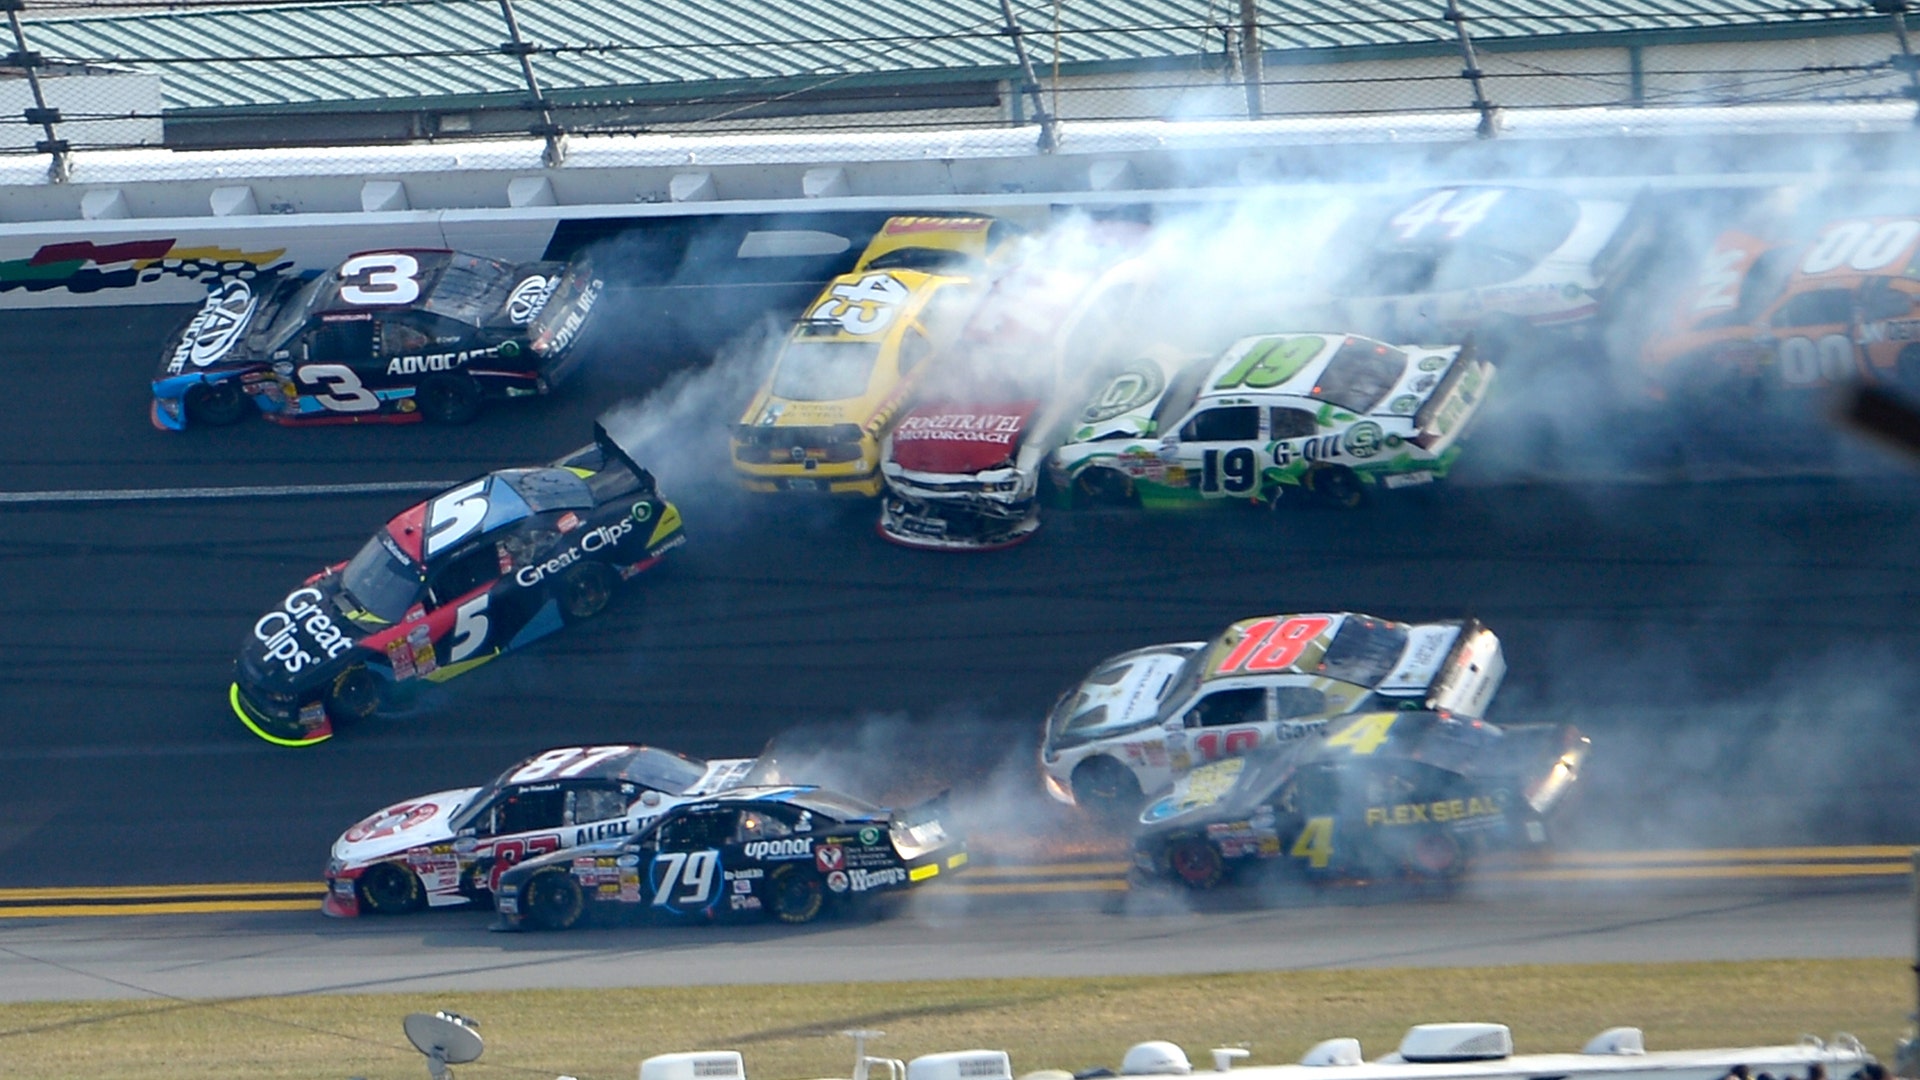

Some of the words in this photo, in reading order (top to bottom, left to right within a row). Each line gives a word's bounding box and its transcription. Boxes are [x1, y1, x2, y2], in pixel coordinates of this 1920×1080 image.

[1392, 189, 1506, 238] 44
[1801, 220, 1920, 275] 00
[340, 253, 419, 305] 3
[811, 273, 910, 335] 43
[1214, 335, 1327, 389] 19
[1780, 334, 1853, 384] 00
[298, 364, 380, 412] 3
[899, 430, 1010, 443] MOTORCOACH
[900, 414, 1021, 432] FORETRAVEL
[1202, 447, 1256, 492] 19
[428, 480, 489, 555] 5
[516, 546, 581, 587] Great
[581, 519, 633, 552] Clips
[254, 611, 312, 673] Clips
[285, 588, 352, 659] Great
[451, 593, 489, 662] 5
[1217, 616, 1333, 675] 18
[1326, 712, 1399, 755] 4
[510, 745, 630, 783] 87
[577, 821, 631, 846] ALERT
[1366, 803, 1429, 828] FLEX
[1431, 796, 1500, 822] SEAL
[744, 837, 814, 860] uponor
[1291, 817, 1335, 868] 4
[653, 850, 720, 905] 79
